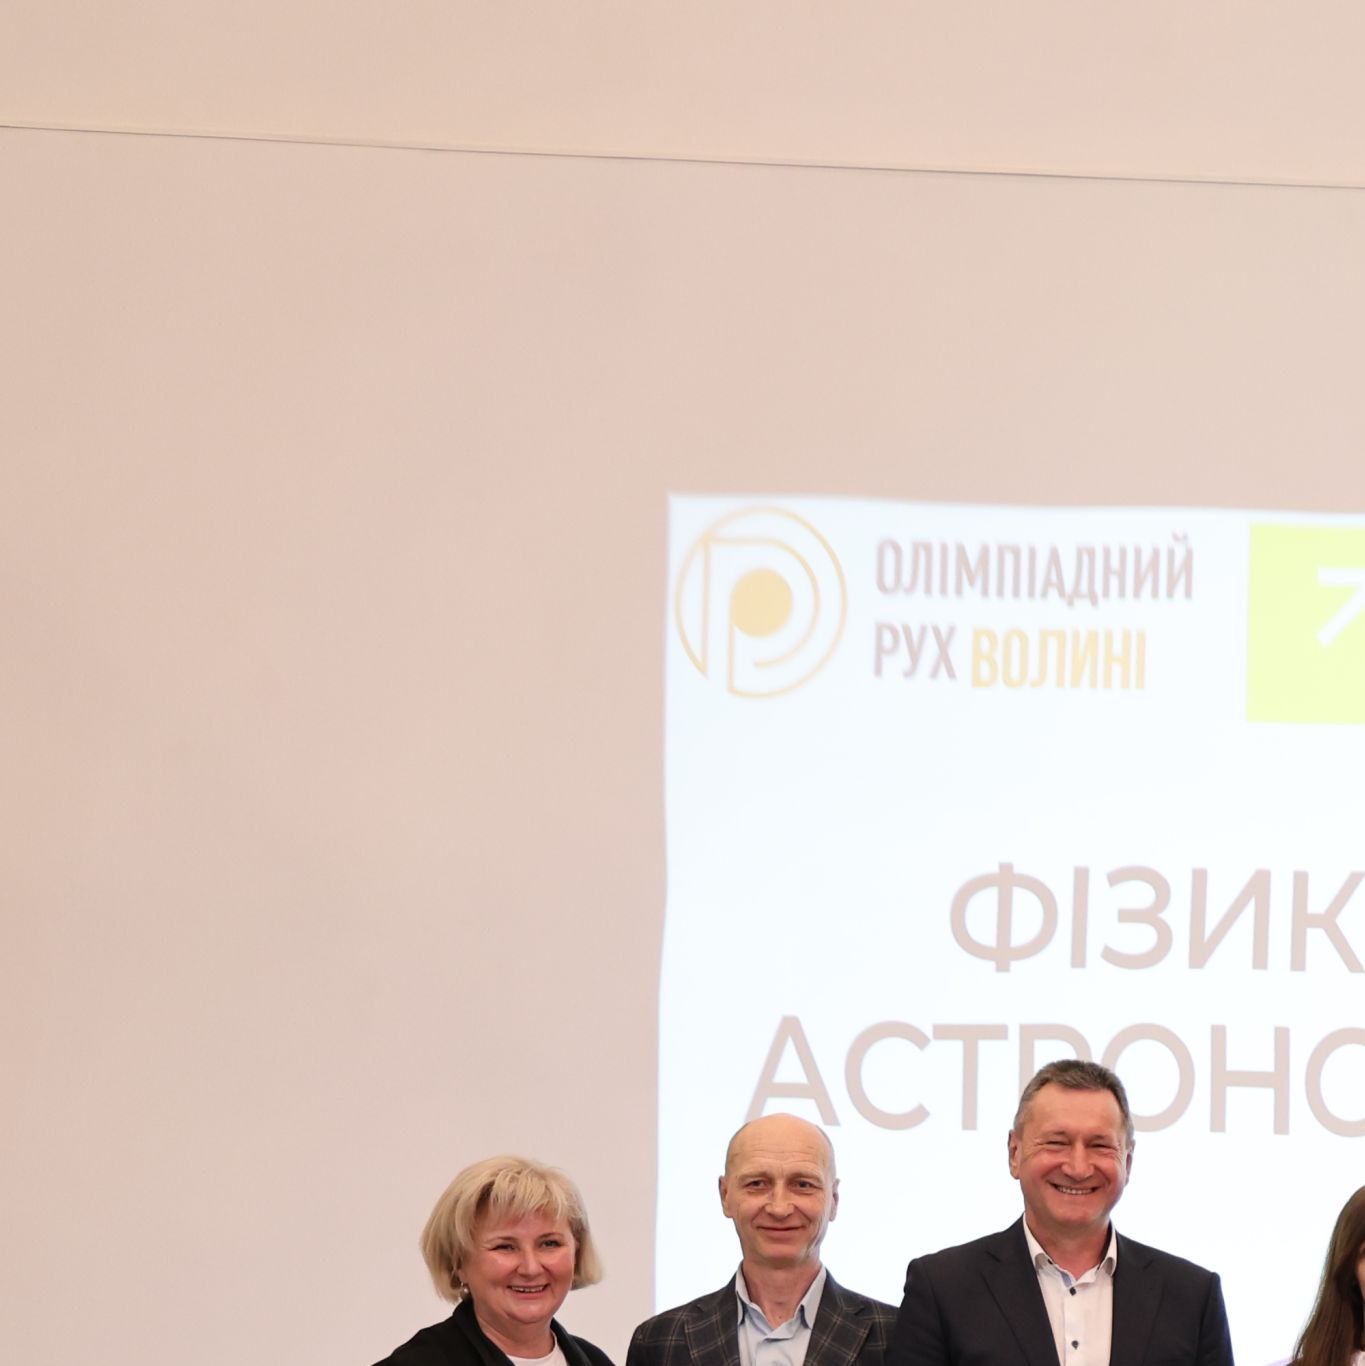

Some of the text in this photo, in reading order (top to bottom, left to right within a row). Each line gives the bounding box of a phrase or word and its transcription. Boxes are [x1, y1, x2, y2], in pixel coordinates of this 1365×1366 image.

[874, 532, 1195, 608] ОЛІМПІАДНИЙ
[874, 624, 1148, 691] РУХ ВОЛИНІ
